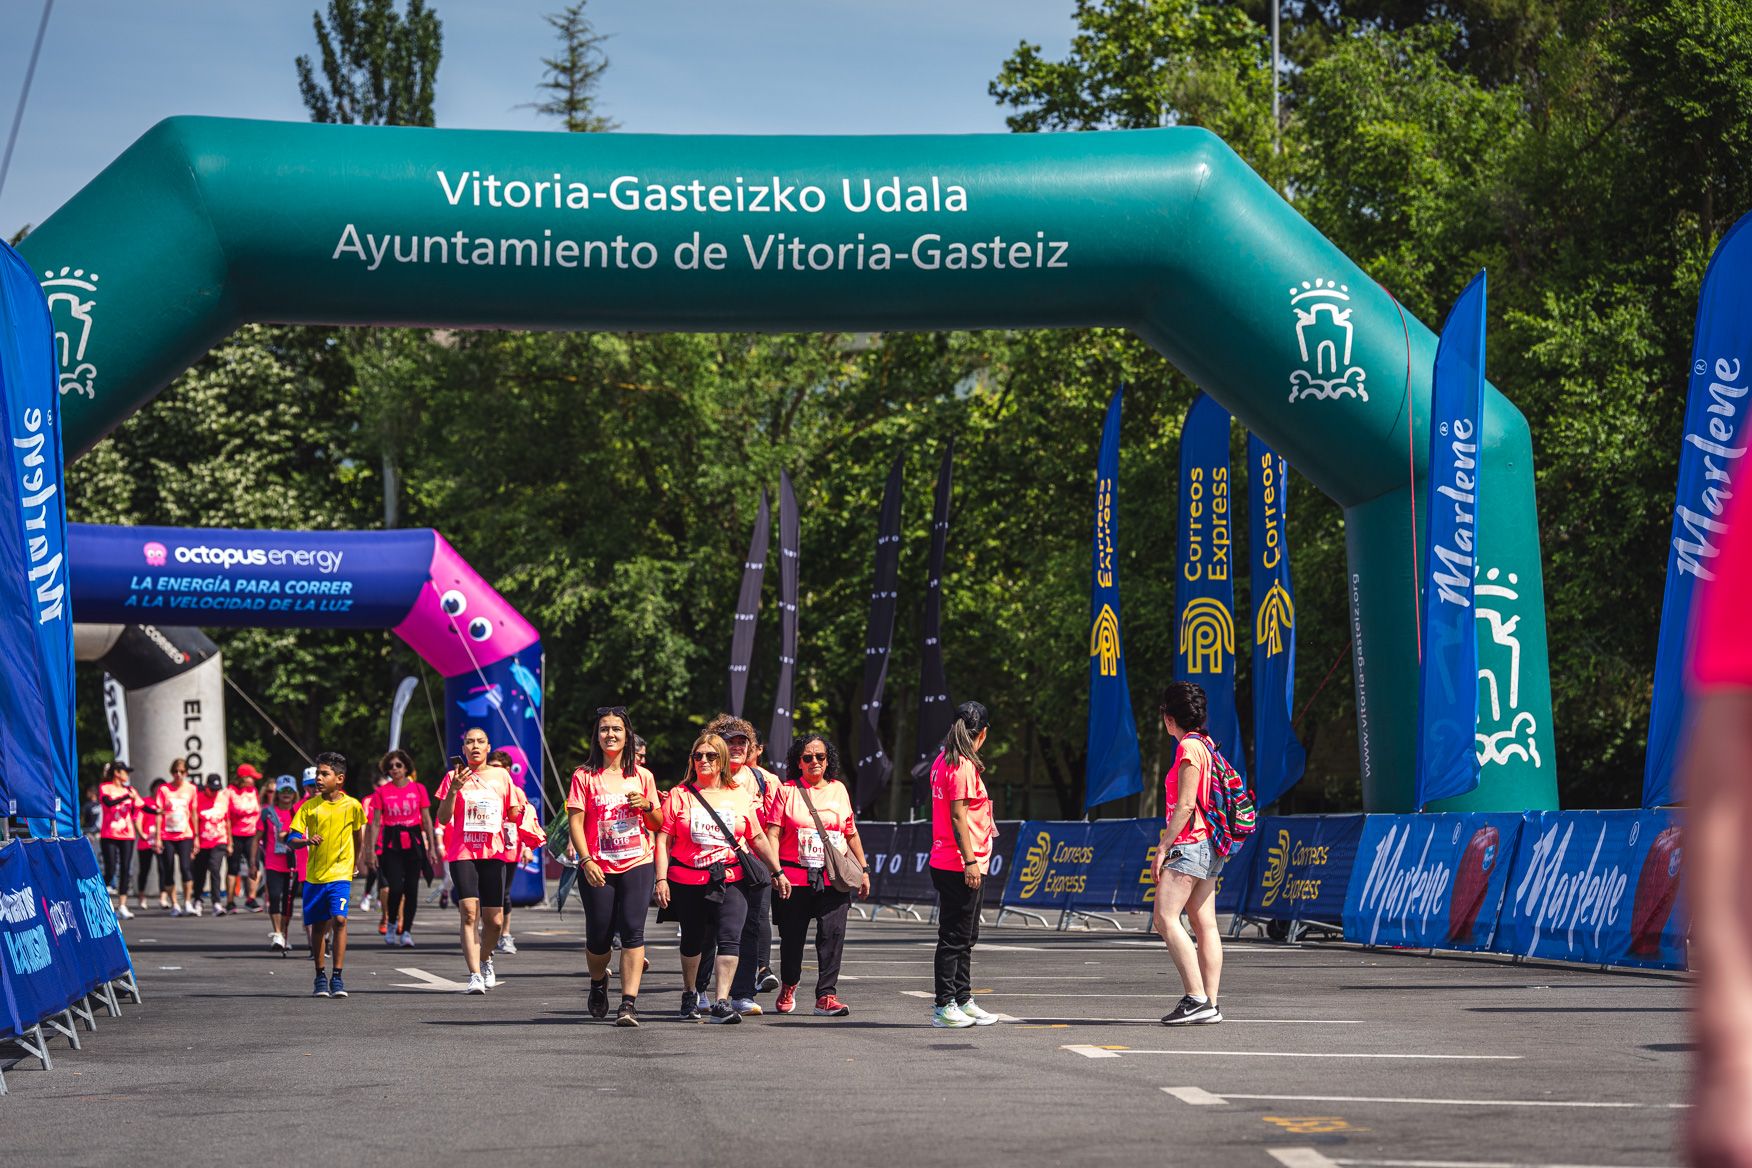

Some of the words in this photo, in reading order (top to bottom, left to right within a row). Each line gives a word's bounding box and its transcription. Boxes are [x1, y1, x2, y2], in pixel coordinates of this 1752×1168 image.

[332, 223, 659, 271] Ayuntamiento
[674, 231, 728, 270] de
[742, 231, 1069, 271] Vitoria-Gasteiz
[436, 170, 826, 213] Vitoria-Gasteizko
[842, 175, 968, 213] Udala
[1184, 467, 1203, 581] Correos
[1208, 467, 1230, 581] Express
[1261, 452, 1280, 569] Correos
[1433, 418, 1477, 607] Marlene
[1673, 357, 1748, 581] Marlene
[125, 595, 137, 606] A
[142, 595, 164, 607] LA
[170, 595, 266, 610] VELOCIDAD
[268, 598, 292, 611] DE
[294, 598, 316, 611] LA
[319, 599, 354, 611] LUZ
[130, 576, 153, 590] LA
[157, 575, 231, 593] ENERGÍA
[234, 579, 281, 594] PARA
[284, 581, 353, 595] CORRER
[1352, 573, 1371, 778] www.vitoria-gasteiz.org
[613, 837, 630, 846] 016
[1044, 869, 1087, 898] Express
[1053, 841, 1094, 863] Correos
[1359, 823, 1450, 946] Marlene
[1513, 821, 1627, 957] Marlene
